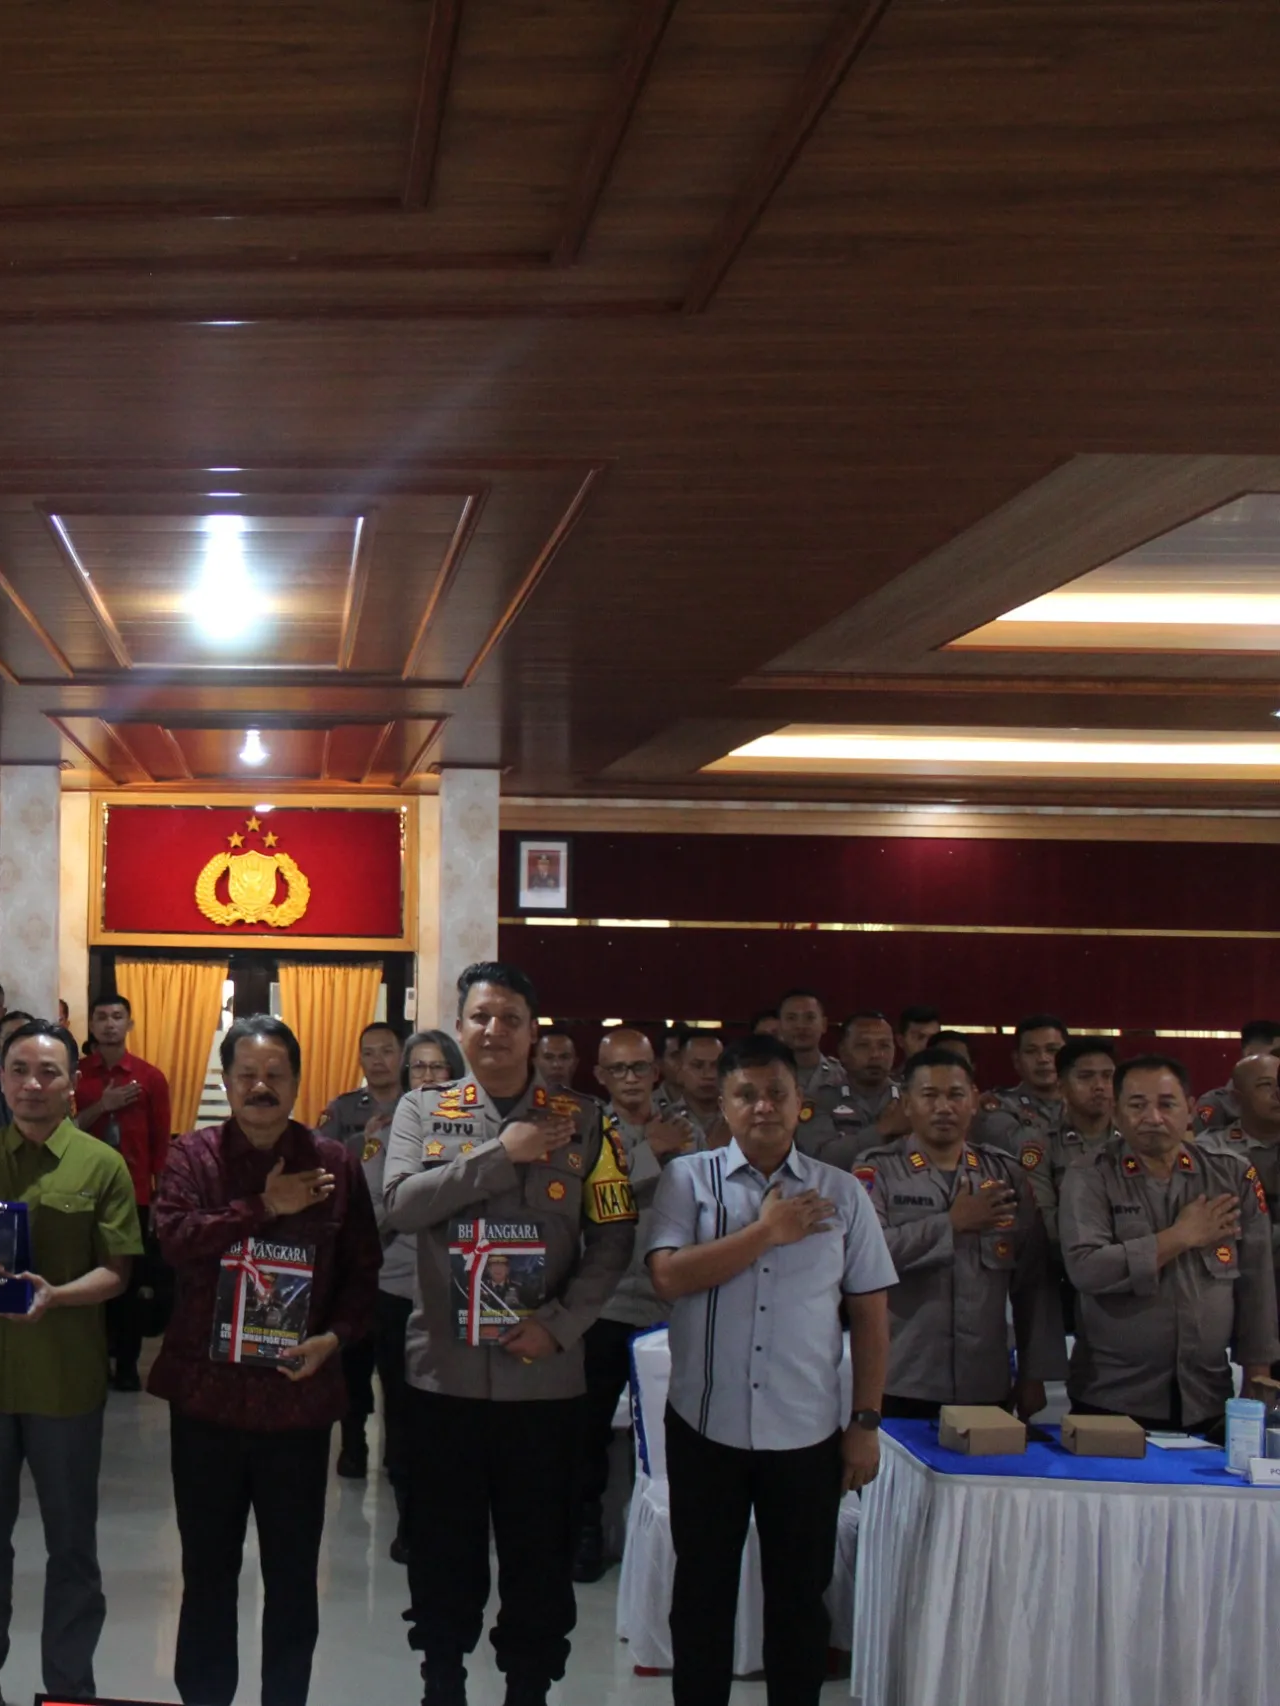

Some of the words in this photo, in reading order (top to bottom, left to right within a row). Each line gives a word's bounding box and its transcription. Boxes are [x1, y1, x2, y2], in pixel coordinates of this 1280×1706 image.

[432, 1122, 473, 1134] PUTU
[600, 1185, 620, 1215] KA
[458, 1223, 539, 1239] BHYANGKARA
